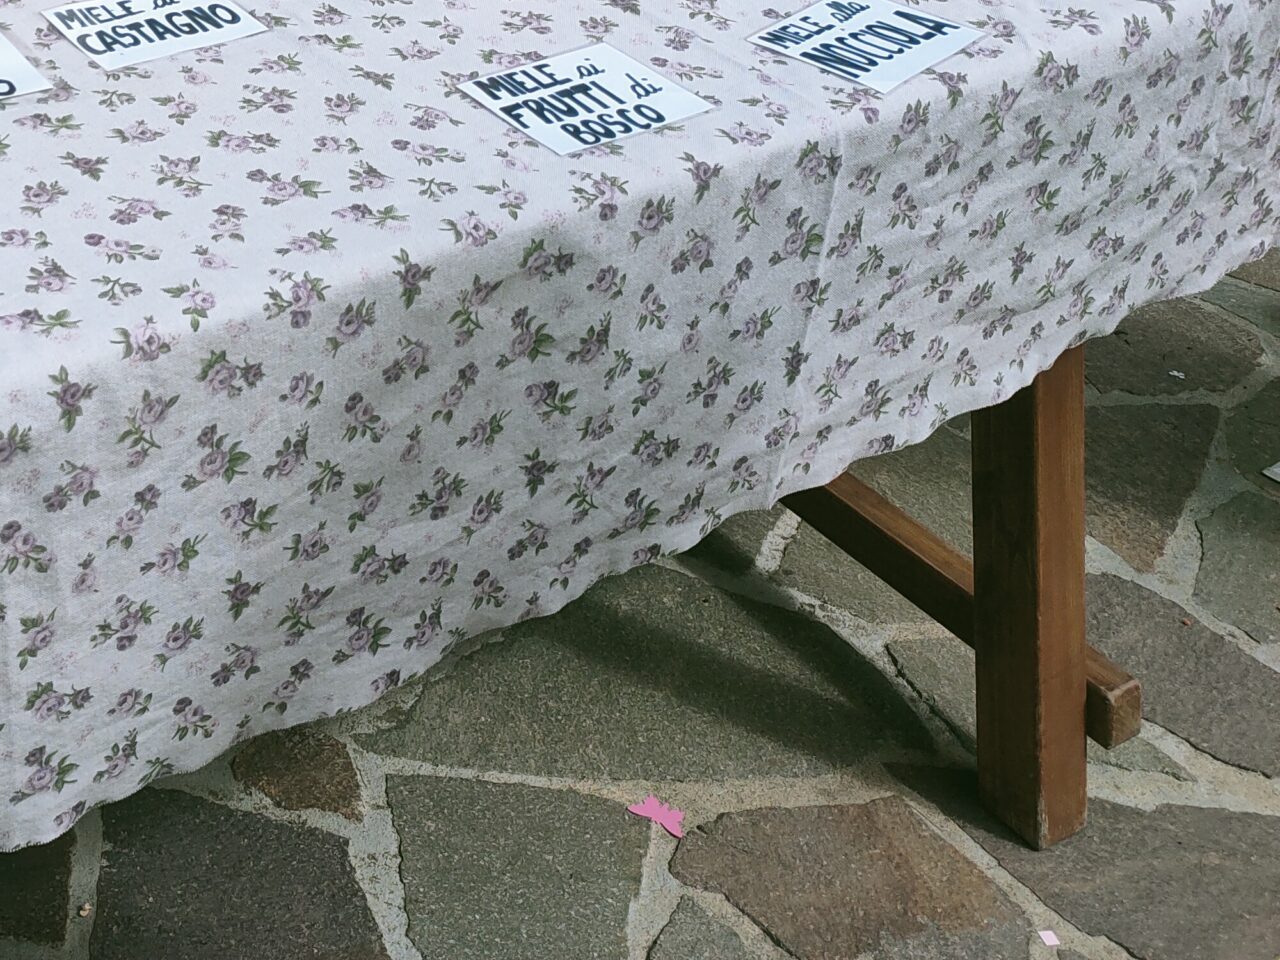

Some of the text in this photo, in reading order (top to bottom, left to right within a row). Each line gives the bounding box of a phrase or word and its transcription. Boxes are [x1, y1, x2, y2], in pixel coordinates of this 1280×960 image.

[53, 0, 145, 30] MIELE
[76, 3, 241, 55] CASTAGNO
[758, 16, 836, 49] MIELE
[799, 10, 961, 79] NOCCIOLA
[472, 63, 573, 100] MIELE
[499, 73, 663, 129] FRUTTI di
[560, 104, 666, 145] BOSCO
